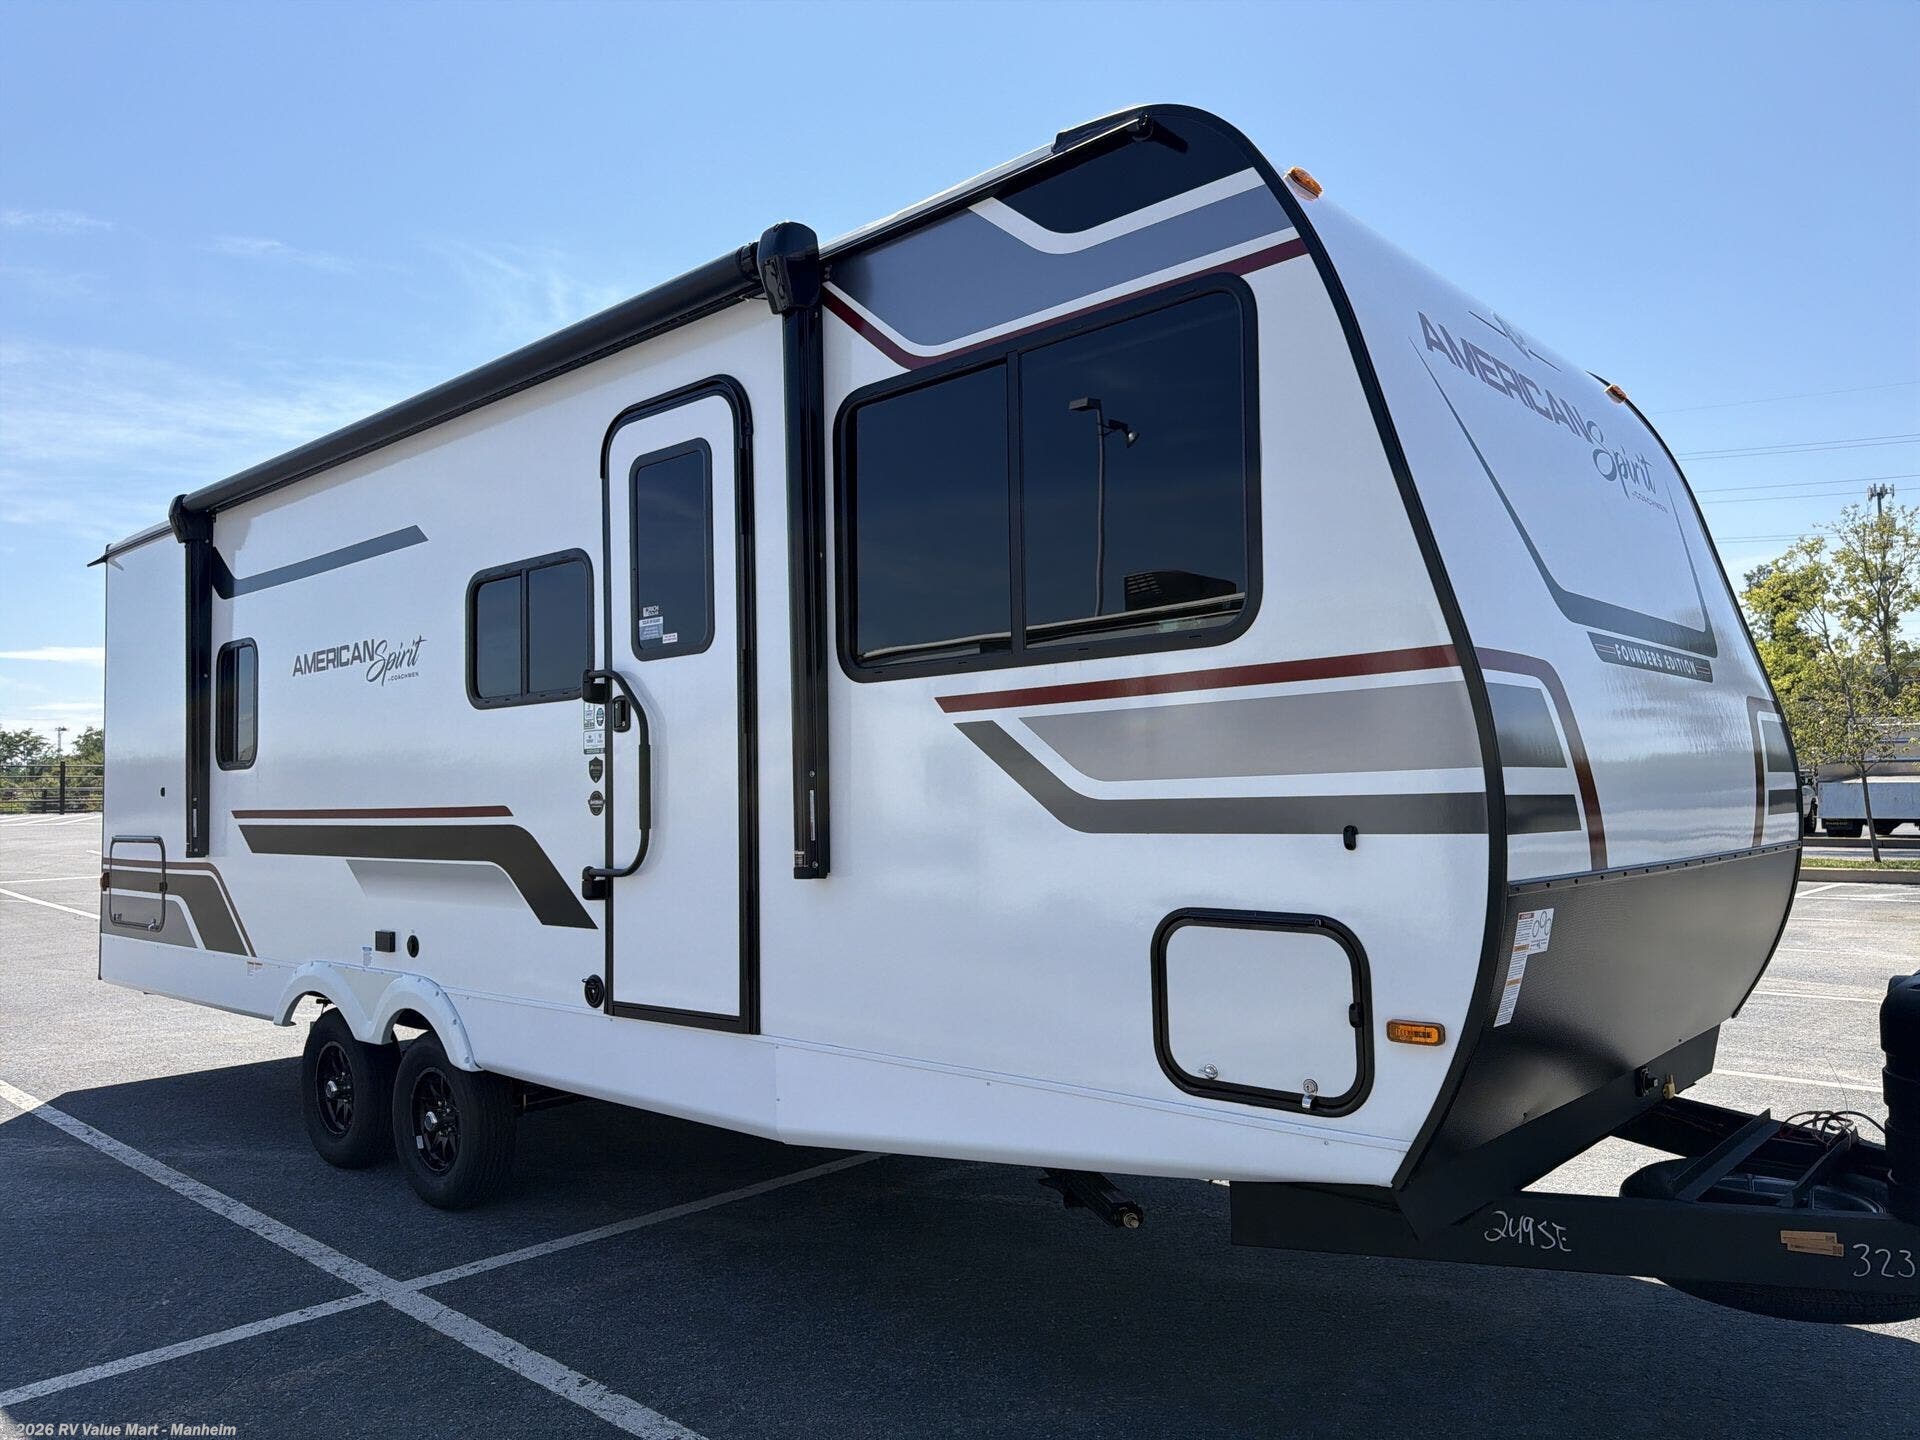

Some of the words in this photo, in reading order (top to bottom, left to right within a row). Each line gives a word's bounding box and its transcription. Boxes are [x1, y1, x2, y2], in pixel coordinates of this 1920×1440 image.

[1417, 310, 1594, 445] AMERICAN
[1586, 420, 1655, 501] Spirit
[292, 638, 375, 677] AMERICAN
[366, 634, 428, 687] Spirit
[1615, 643, 1664, 669] FOUNDERS
[1663, 654, 1698, 676] EDITION
[1484, 1210, 1573, 1253] 249SE
[1852, 1243, 1916, 1278] 323
